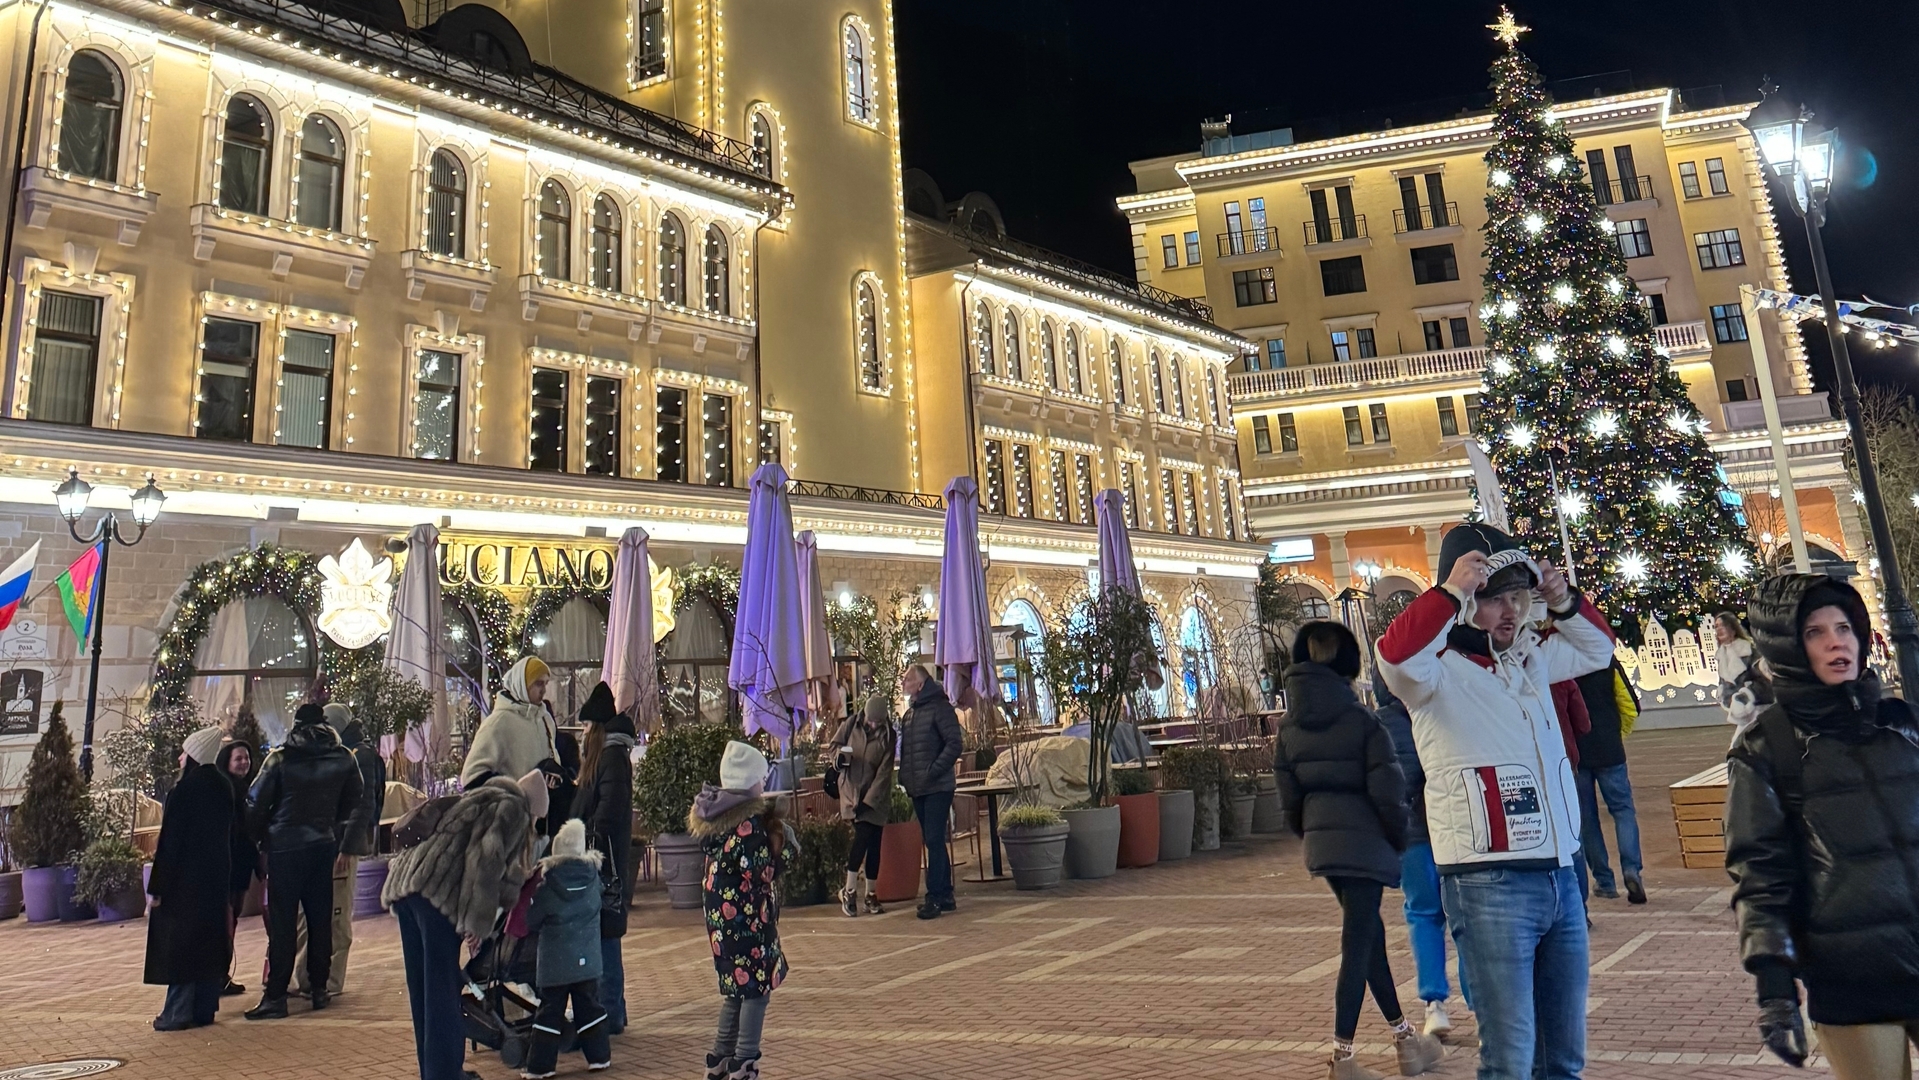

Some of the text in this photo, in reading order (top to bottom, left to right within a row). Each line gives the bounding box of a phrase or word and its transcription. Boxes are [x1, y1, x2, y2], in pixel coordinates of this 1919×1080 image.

[439, 542, 614, 588] UCIANO
[24, 623, 30, 631] 2
[1501, 780, 1533, 788] MANZONI
